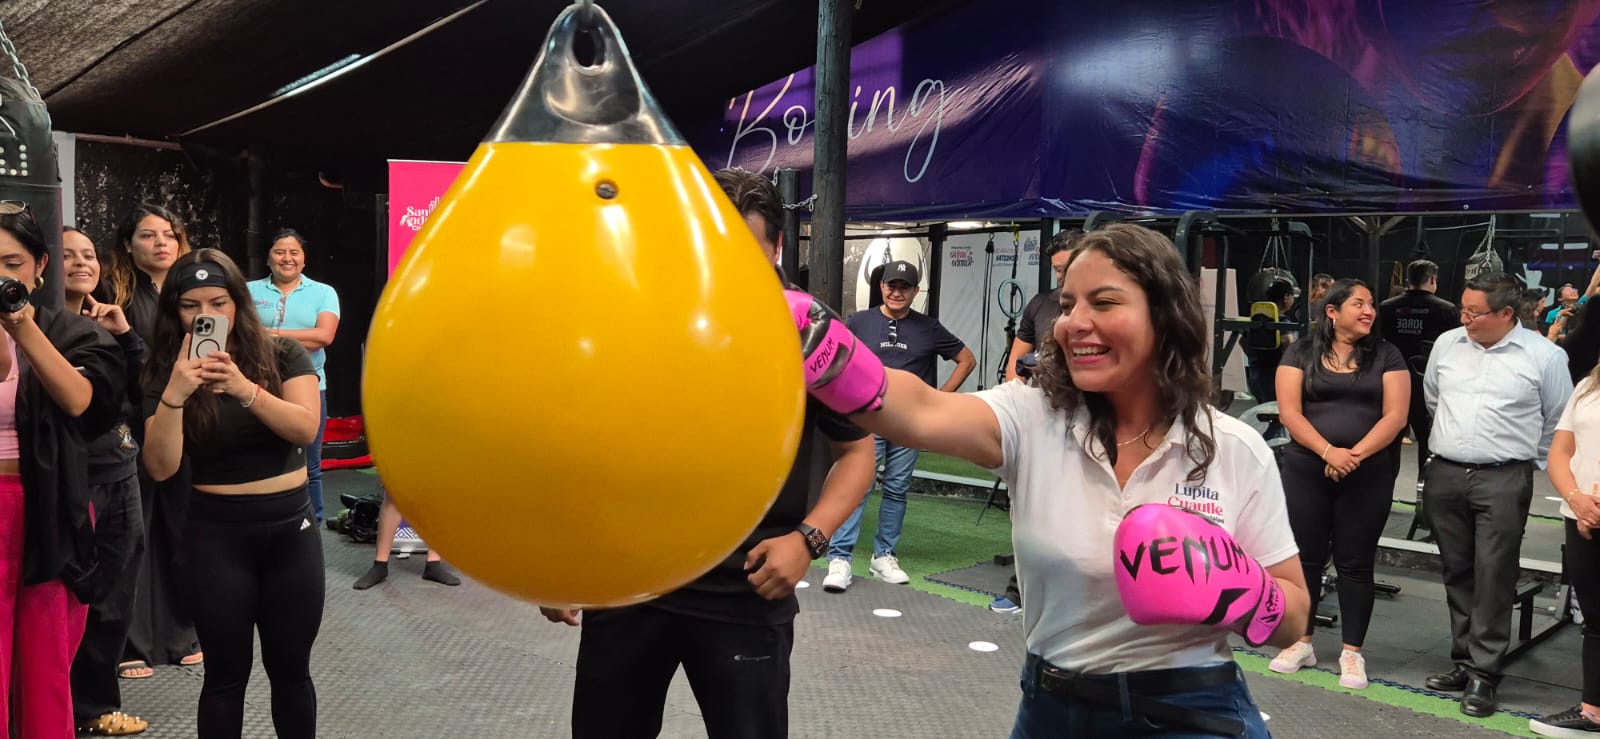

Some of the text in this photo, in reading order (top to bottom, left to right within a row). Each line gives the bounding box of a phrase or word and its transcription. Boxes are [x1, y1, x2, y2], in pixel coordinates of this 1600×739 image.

[728, 74, 962, 183] Boing
[406, 205, 428, 217] San
[810, 337, 835, 373] VENUM
[1175, 483, 1219, 500] Lupita
[1168, 496, 1223, 516] Cuautle
[1120, 536, 1250, 585] VENUM
